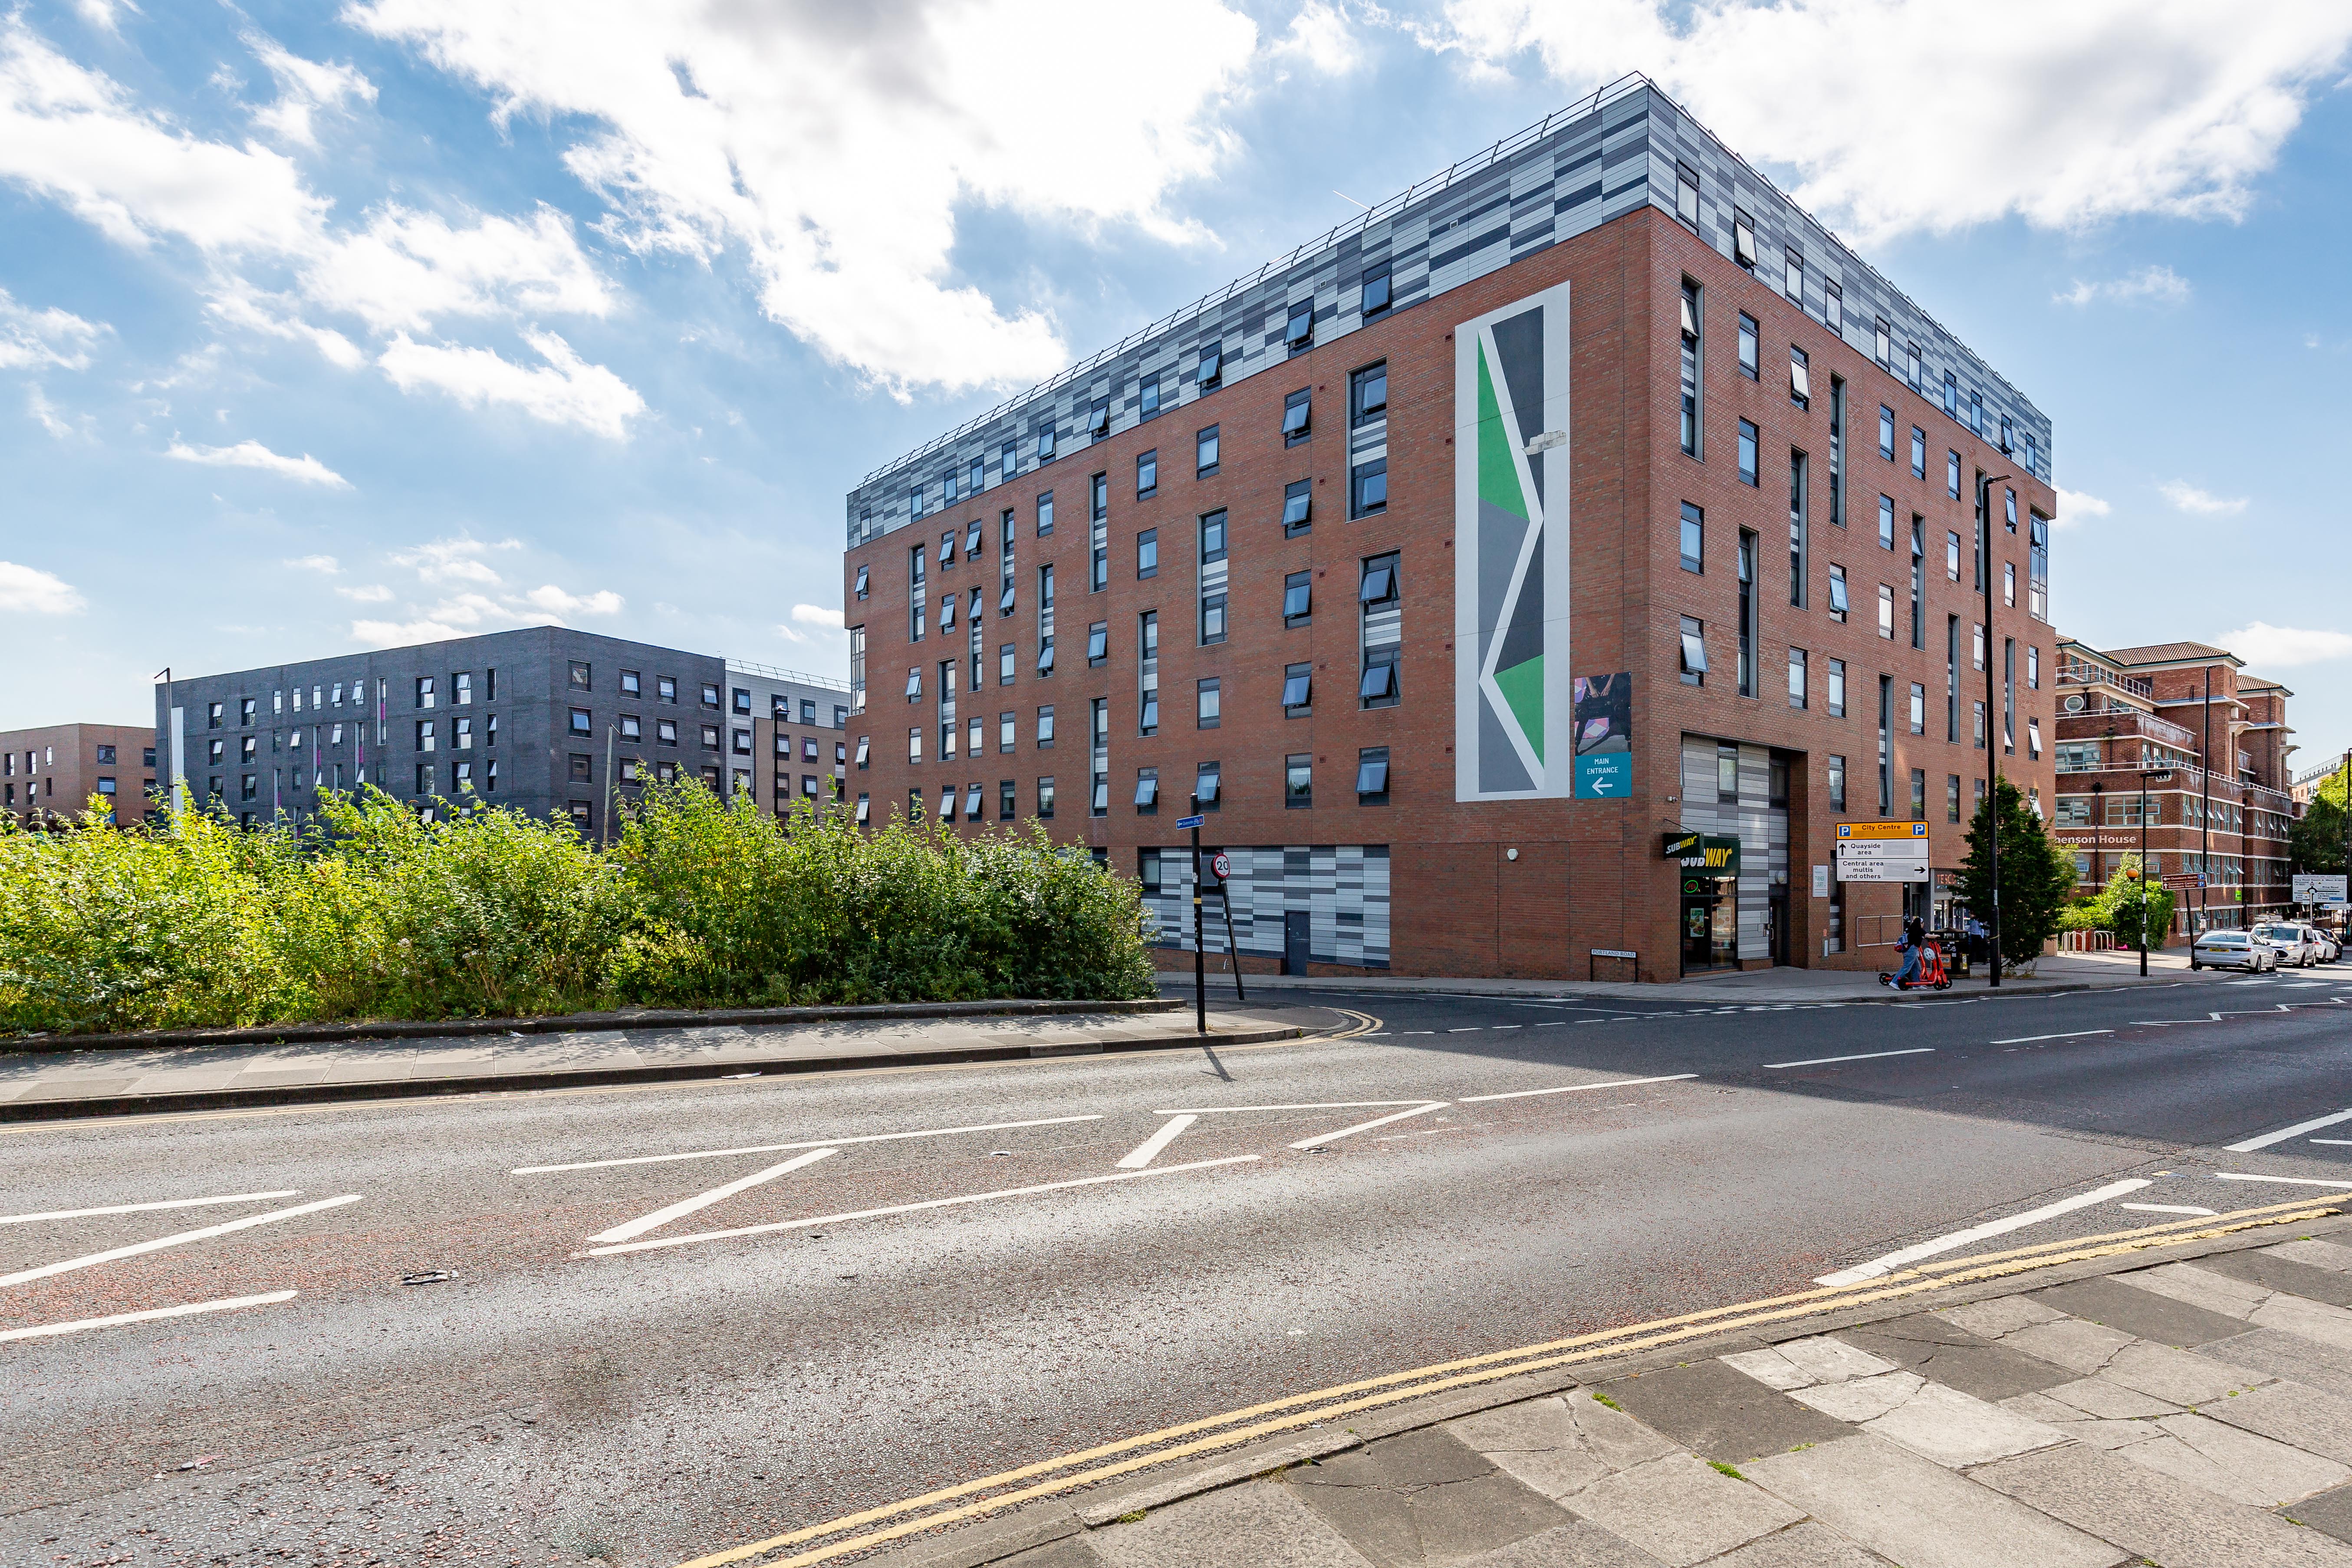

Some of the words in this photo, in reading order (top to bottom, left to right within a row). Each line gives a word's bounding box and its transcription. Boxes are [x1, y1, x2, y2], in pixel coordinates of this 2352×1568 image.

[1587, 766, 1618, 775] ENTRANCE
[1666, 835, 1697, 854] SUBWAY
[1217, 861, 1229, 871] 20
